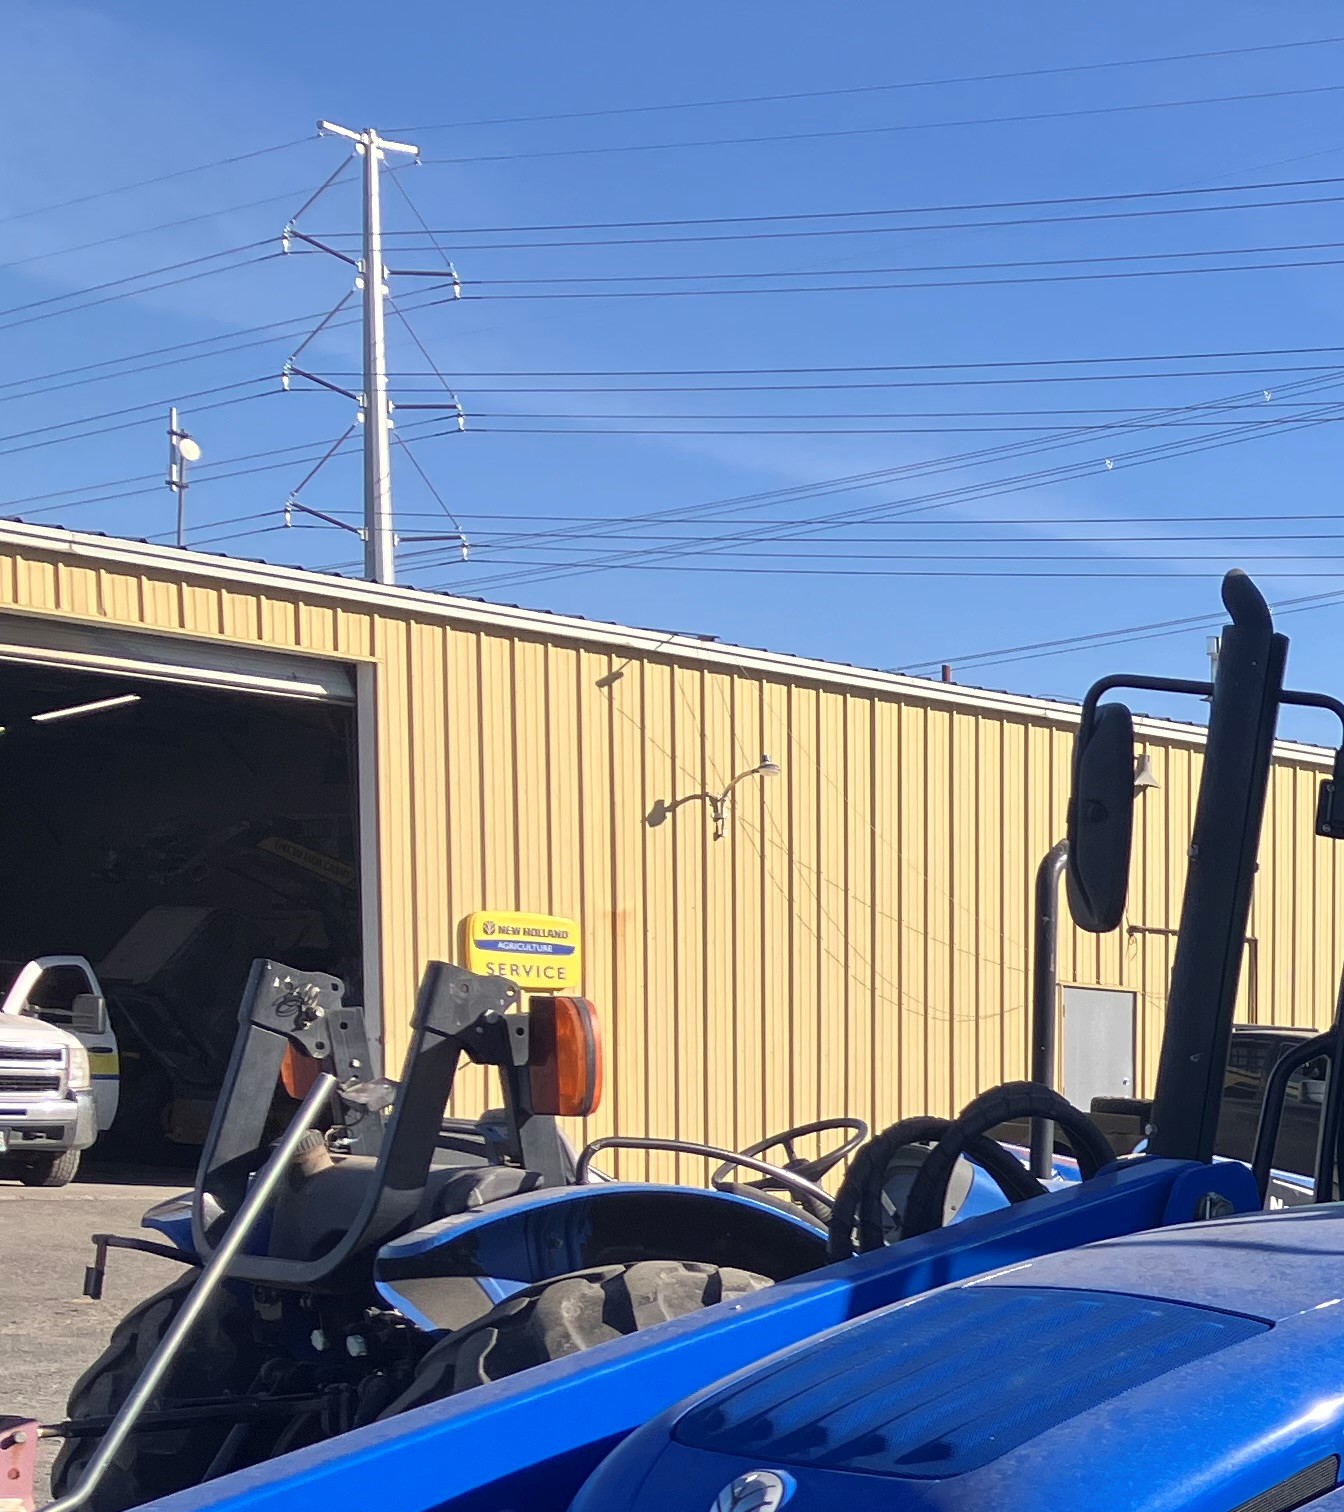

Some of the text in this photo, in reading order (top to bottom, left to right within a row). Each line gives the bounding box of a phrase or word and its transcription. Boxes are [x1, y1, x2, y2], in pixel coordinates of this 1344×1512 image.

[498, 925, 569, 939] NEW HOLLAND
[498, 941, 553, 952] AGRICULTURE
[486, 962, 567, 980] SERVICE
